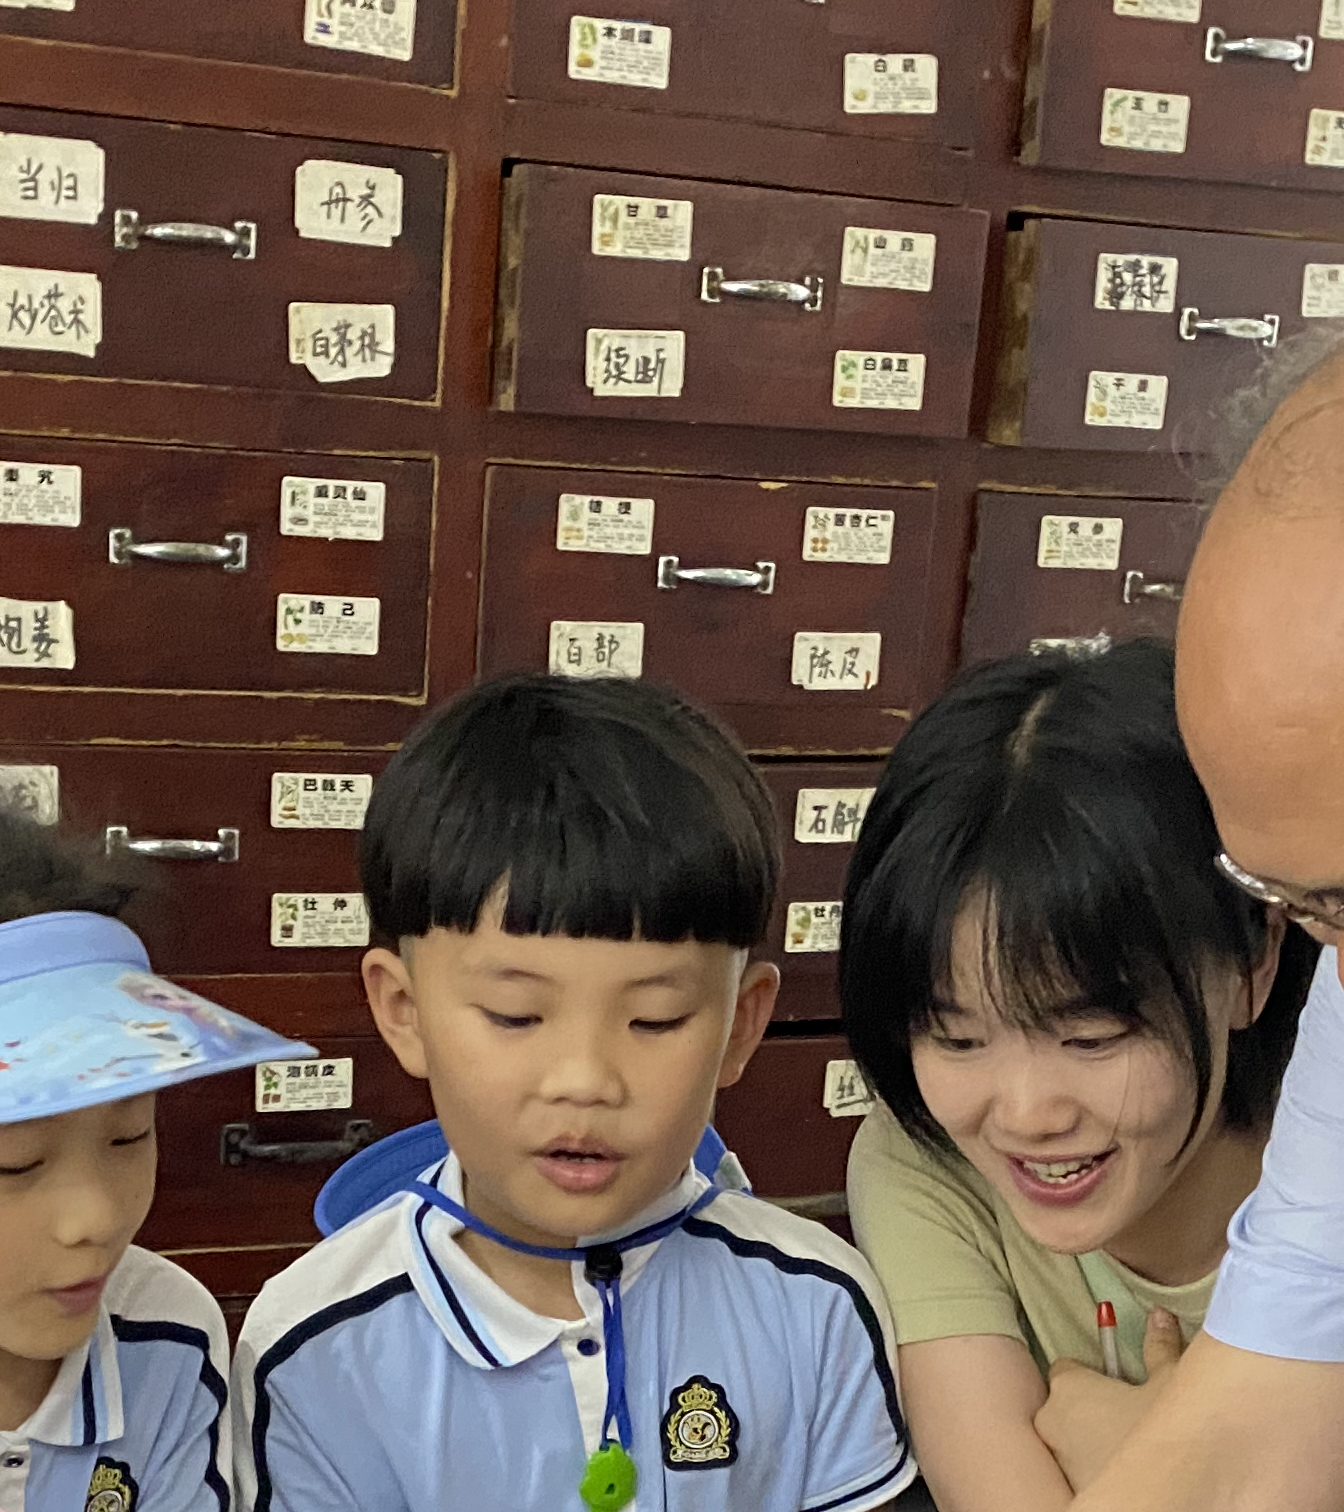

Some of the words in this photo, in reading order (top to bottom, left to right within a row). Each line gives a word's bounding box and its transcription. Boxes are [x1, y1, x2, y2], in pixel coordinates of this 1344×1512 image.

[19, 157, 78, 206] 当归
[320, 180, 384, 233] 丹参
[626, 204, 669, 219] 甘草
[602, 345, 668, 396] 续断
[309, 601, 355, 616] 防己
[566, 632, 621, 669] 百部
[808, 645, 862, 685] 陈皮
[302, 778, 356, 794] 巴戟天
[302, 897, 348, 912] 杜仲
